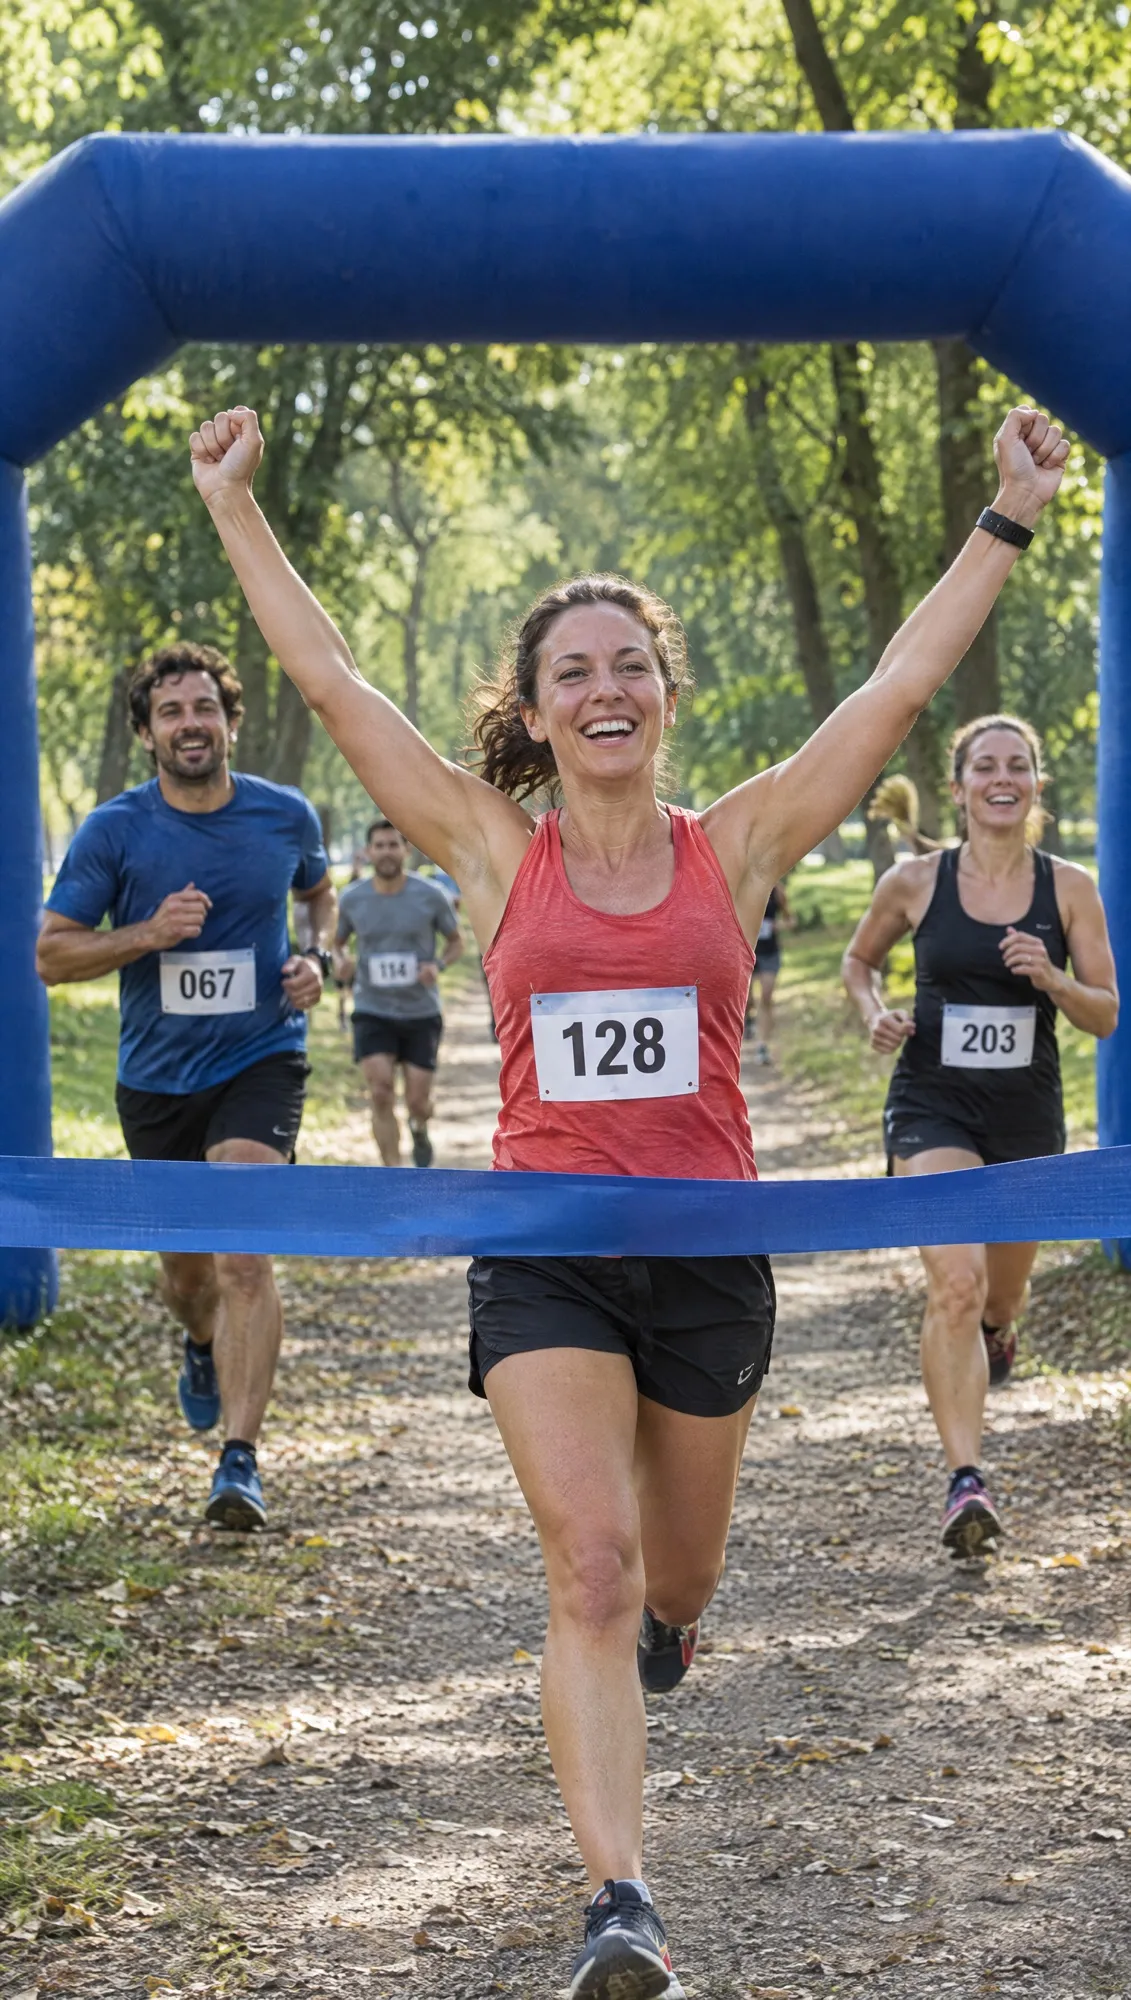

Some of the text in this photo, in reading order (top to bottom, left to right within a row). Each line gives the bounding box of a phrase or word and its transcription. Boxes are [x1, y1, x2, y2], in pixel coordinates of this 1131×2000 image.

[179, 968, 235, 1000] 067
[379, 961, 407, 979] 114
[562, 1017, 666, 1077] 128
[961, 1024, 1016, 1054] 203
